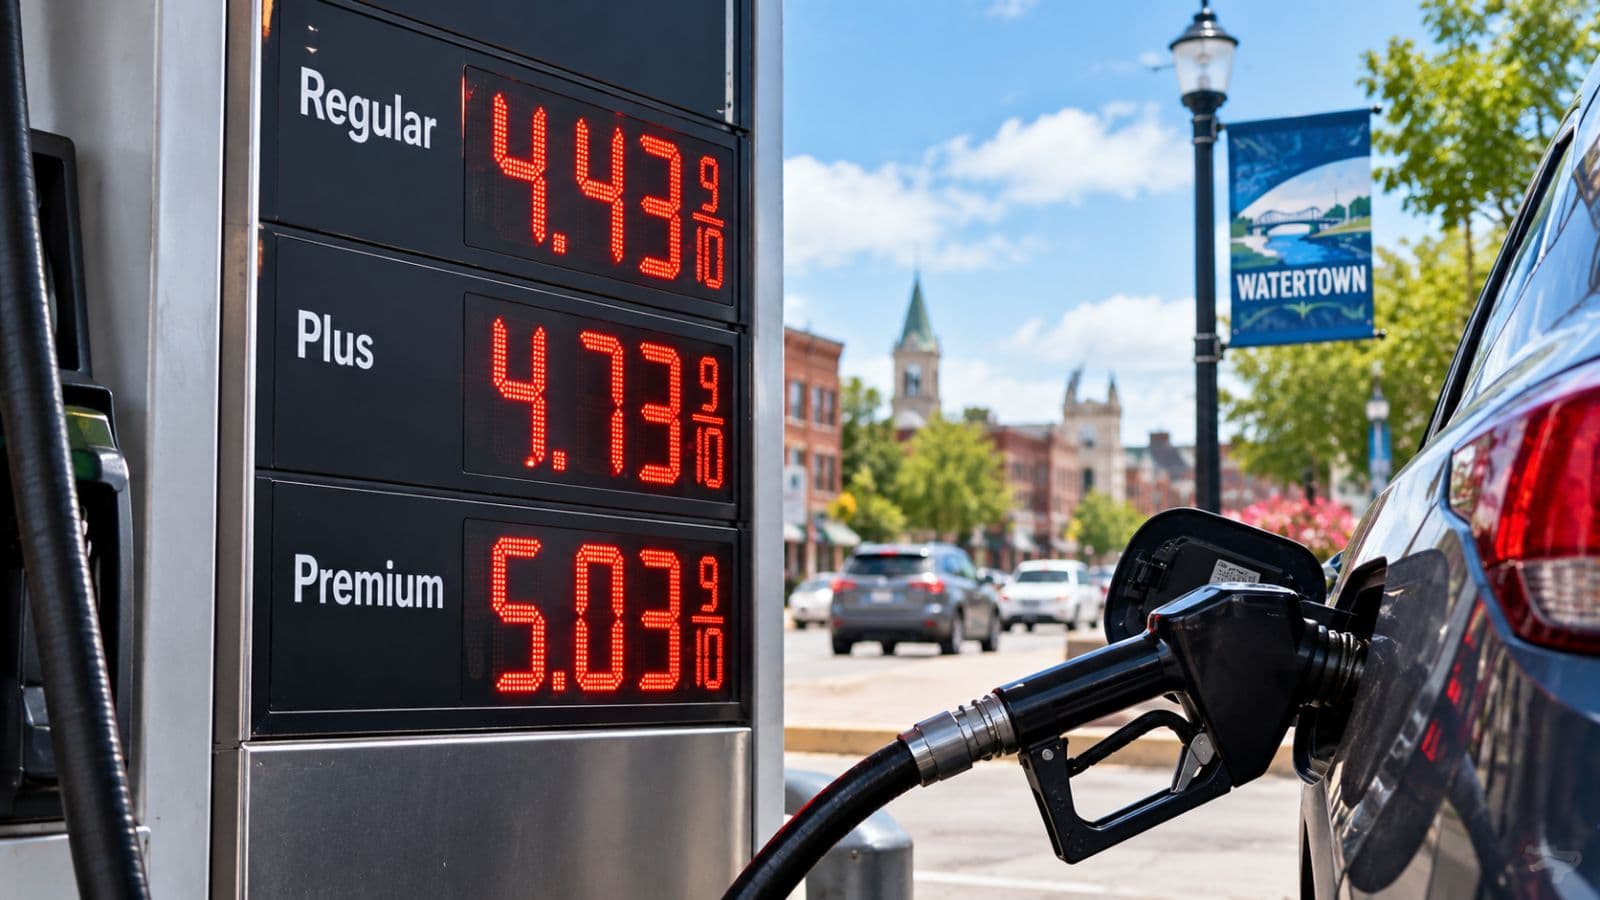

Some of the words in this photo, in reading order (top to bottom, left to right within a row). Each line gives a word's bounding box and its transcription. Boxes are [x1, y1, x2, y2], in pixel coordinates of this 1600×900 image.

[300, 66, 437, 149] Regular
[493, 92, 682, 280] 4.43
[1237, 265, 1367, 300] WATERTOWN
[297, 309, 374, 370] Plus
[492, 317, 682, 485] 4.73
[294, 553, 444, 609] Premium
[491, 536, 681, 693] 5.03
